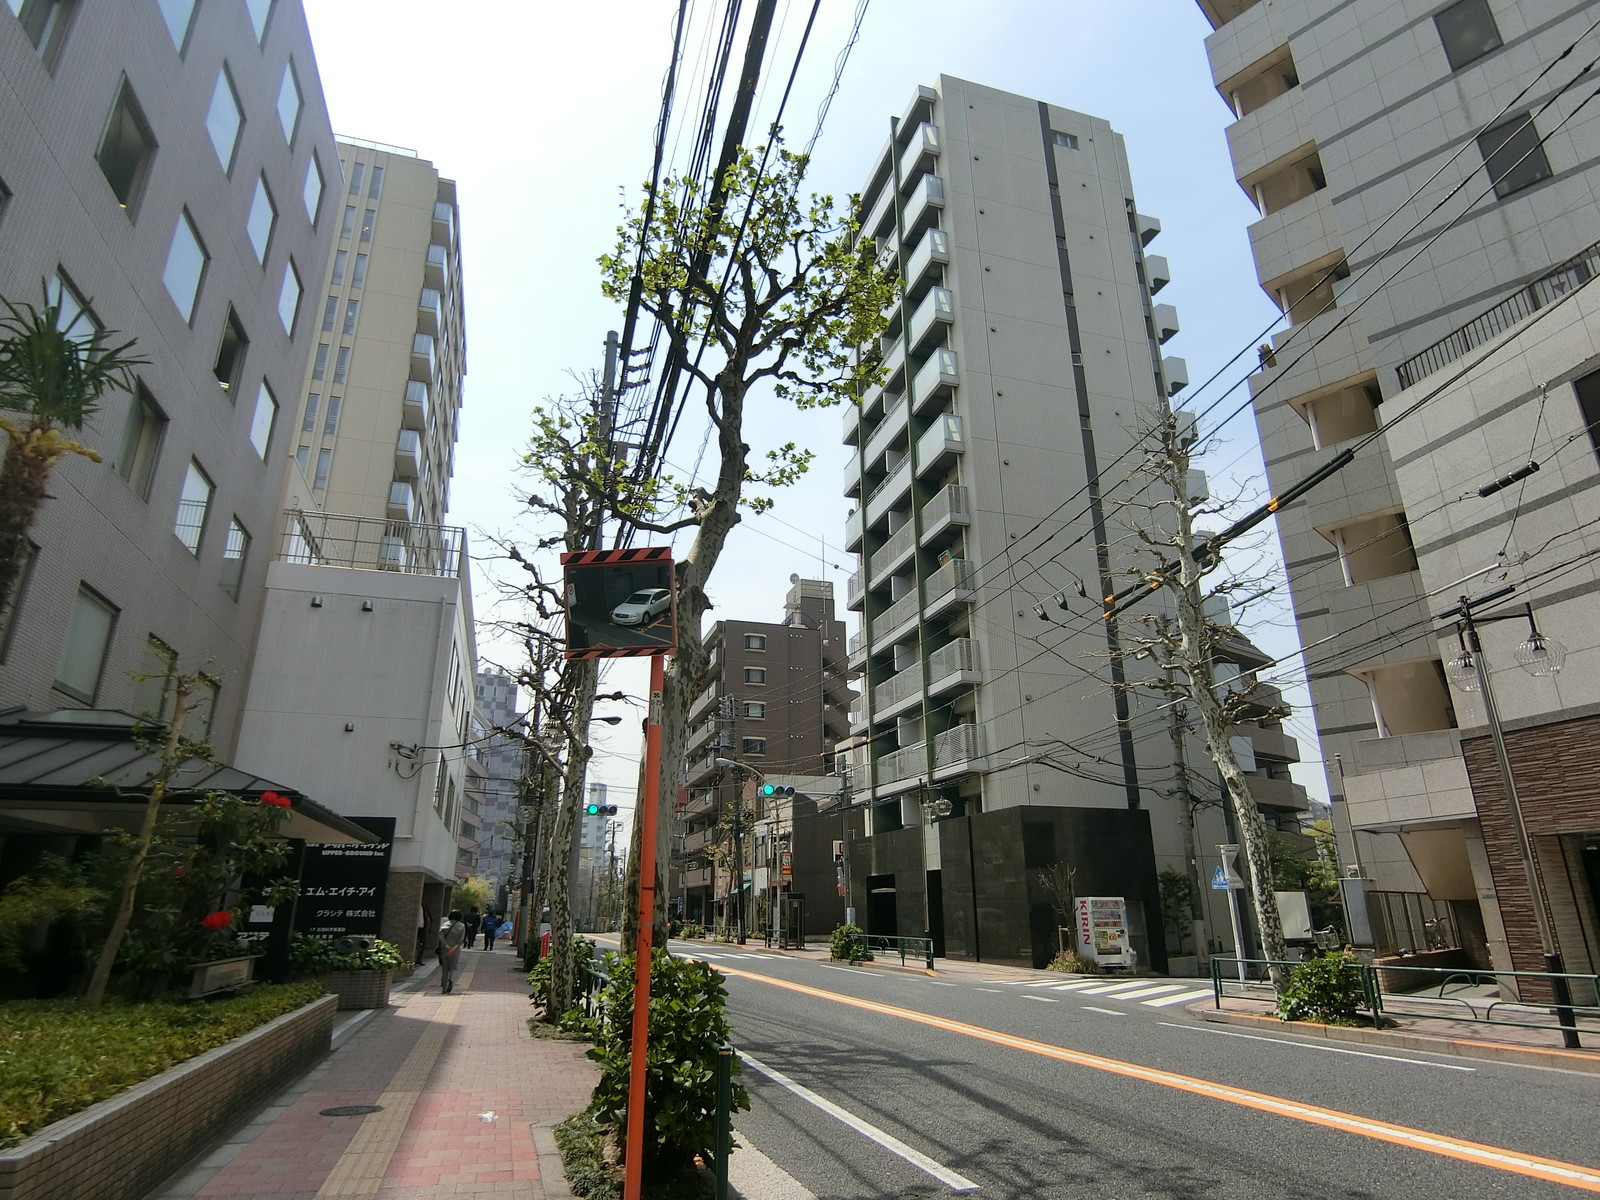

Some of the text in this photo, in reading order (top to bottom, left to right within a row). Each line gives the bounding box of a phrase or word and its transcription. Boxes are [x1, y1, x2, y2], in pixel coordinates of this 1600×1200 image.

[305, 886, 377, 897] エム・エイチ・アイ
[316, 909, 376, 918] クラシテ 株式会社
[1079, 900, 1091, 945] KIRIN
